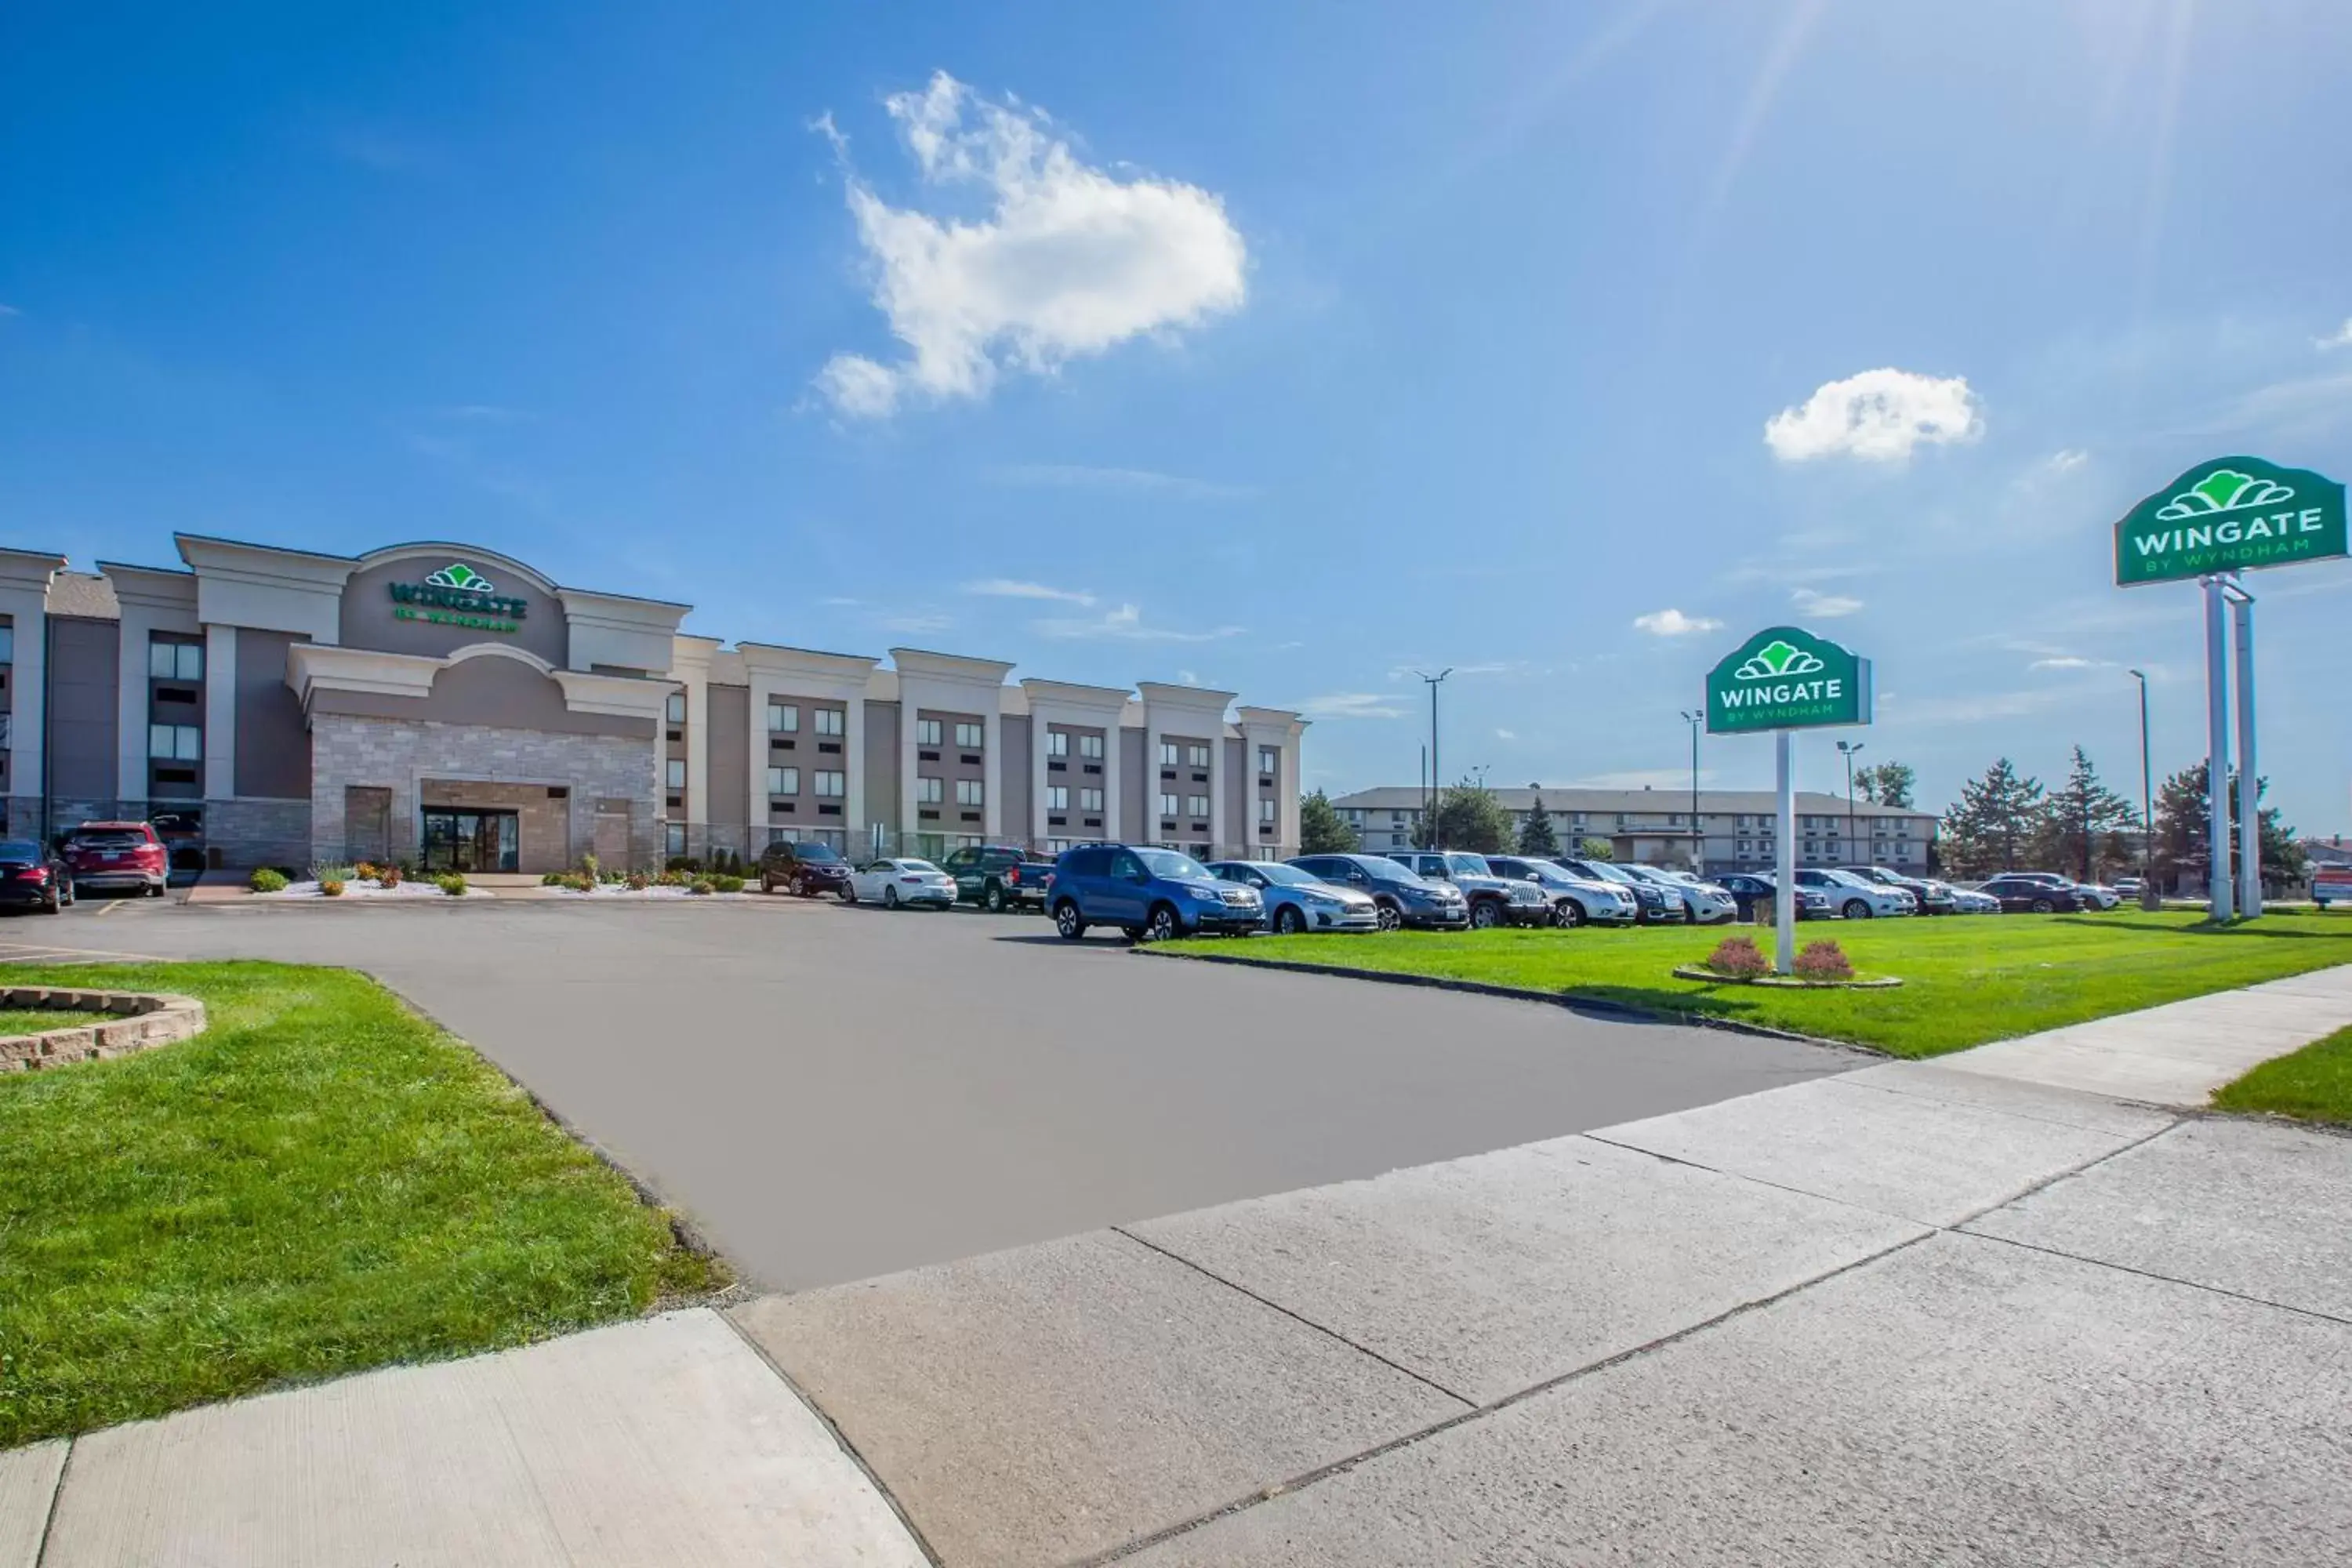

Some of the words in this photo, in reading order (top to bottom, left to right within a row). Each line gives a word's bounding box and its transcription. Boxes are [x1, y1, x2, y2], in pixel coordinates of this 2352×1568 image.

[2134, 508, 2323, 556] WINGATE
[2146, 559, 2171, 572] BY
[2183, 539, 2310, 566] WYNDHAM
[389, 583, 528, 619] WINGATE
[1720, 679, 1842, 708] WINGATE
[1727, 711, 1745, 721] BY
[1753, 705, 1833, 719] WYNDHAM
